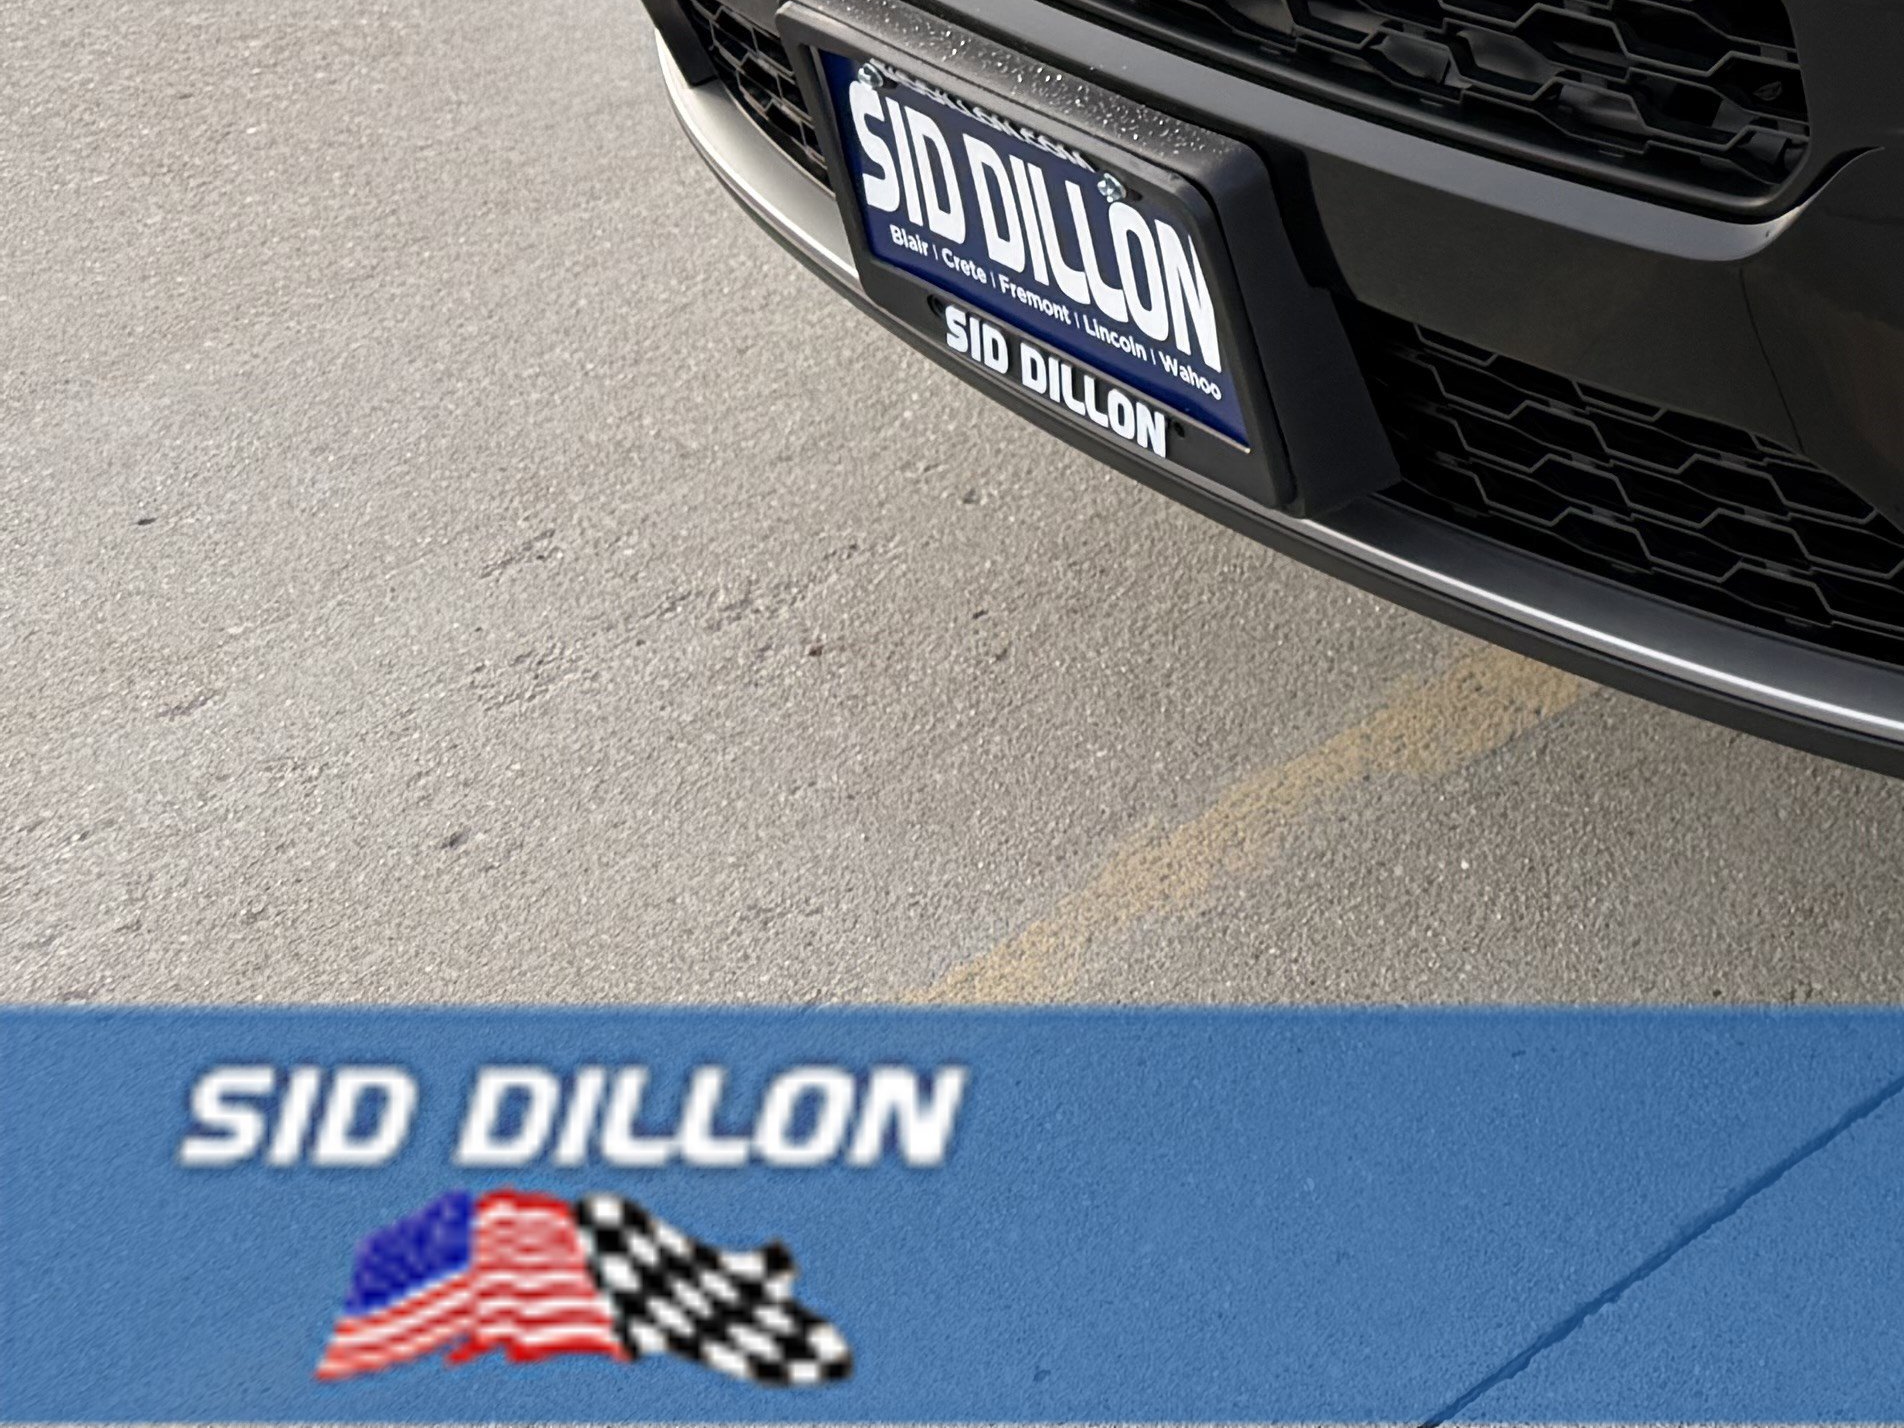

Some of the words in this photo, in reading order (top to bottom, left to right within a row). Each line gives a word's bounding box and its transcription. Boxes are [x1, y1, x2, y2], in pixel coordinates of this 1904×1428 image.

[849, 80, 966, 245] SID
[963, 132, 1222, 374] DILLON
[890, 224, 929, 258] Blair
[942, 248, 988, 284] Crete
[999, 273, 1071, 324] Fremont
[1083, 314, 1148, 362] Lincoln
[1159, 350, 1222, 401] Wahoo
[945, 304, 1009, 375] SID
[1020, 342, 1167, 459] DILLON
